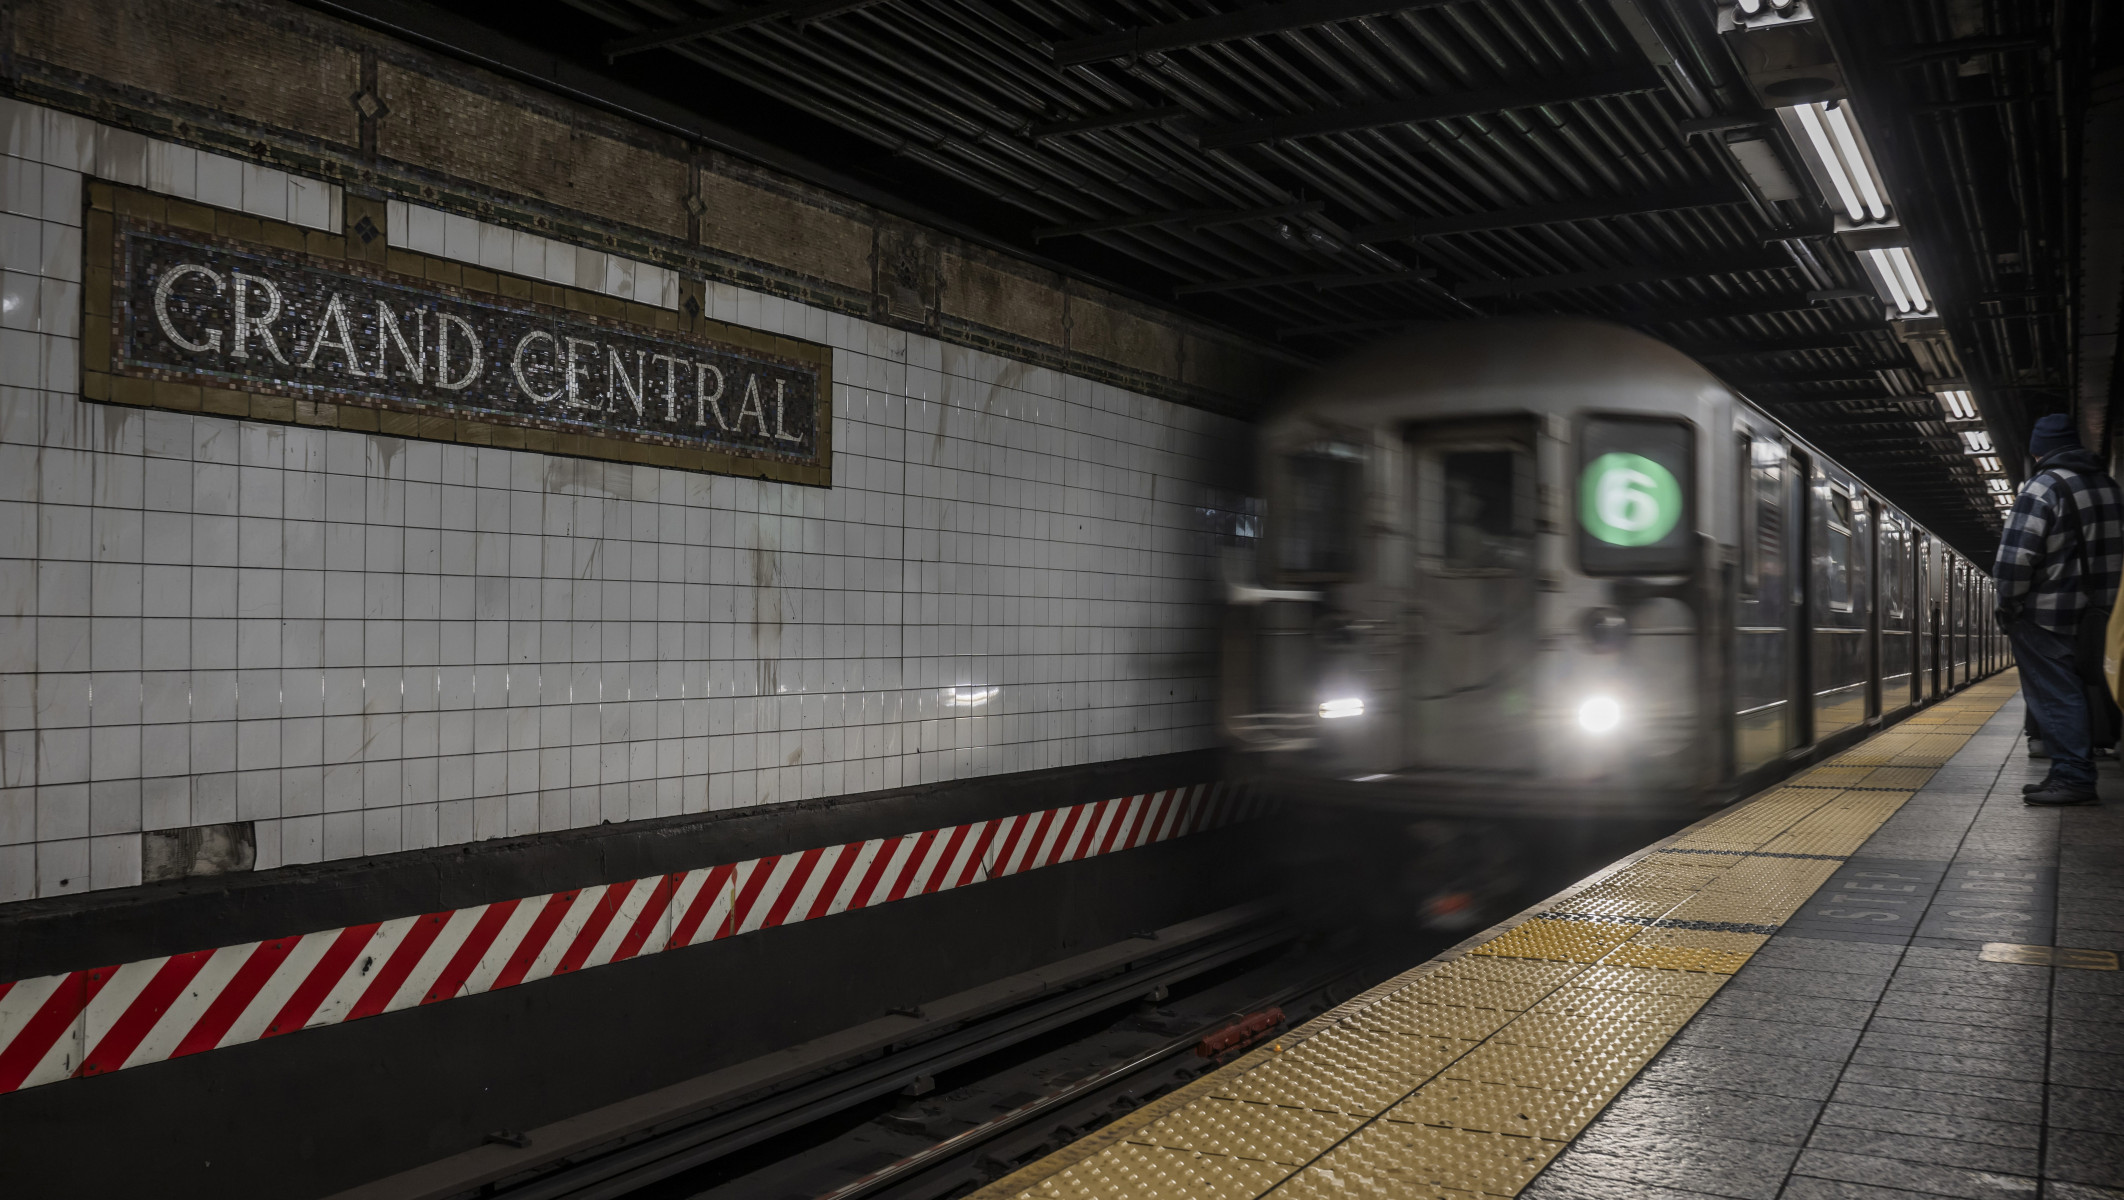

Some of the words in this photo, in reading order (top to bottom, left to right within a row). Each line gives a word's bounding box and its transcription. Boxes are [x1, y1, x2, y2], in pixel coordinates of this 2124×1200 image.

[153, 263, 484, 391] GRAND
[512, 329, 804, 442] CENTRAL
[1596, 467, 1659, 532] 6
[1818, 870, 1922, 922] STEP
[1943, 869, 2038, 941] ASIDE
